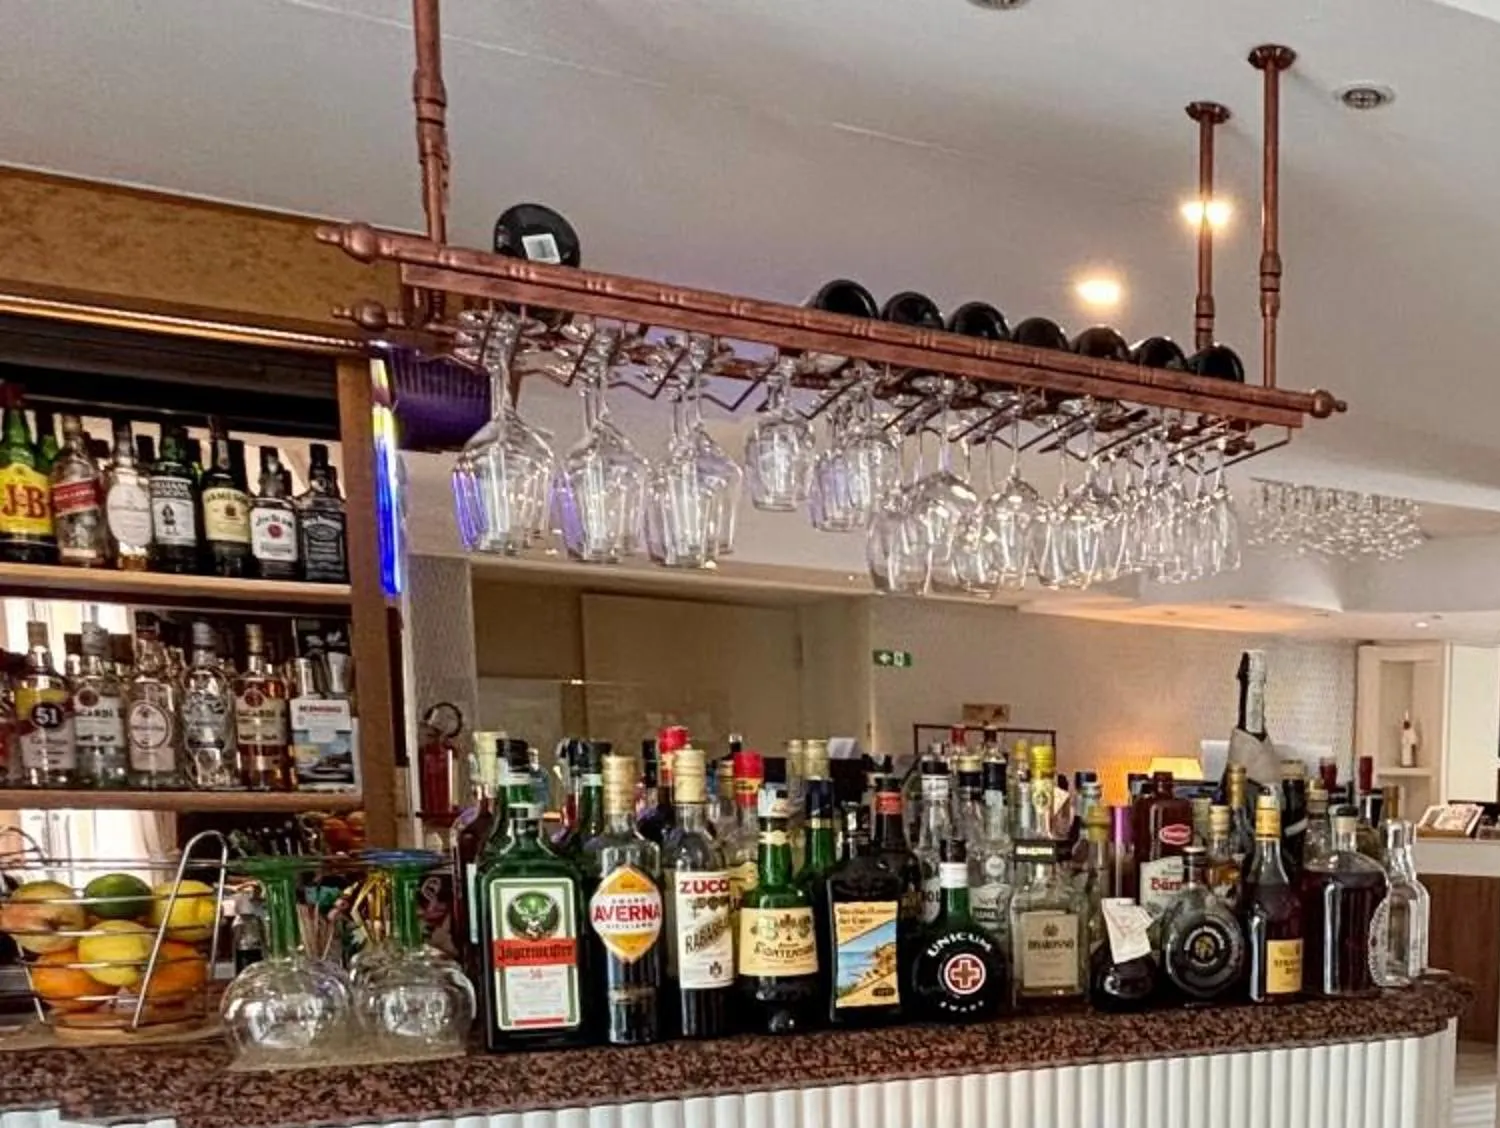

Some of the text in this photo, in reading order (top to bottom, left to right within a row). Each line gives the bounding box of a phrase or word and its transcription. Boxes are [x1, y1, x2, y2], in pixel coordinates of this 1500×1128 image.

[35, 707, 58, 725] 51
[593, 903, 661, 923] AVERNA
[926, 932, 992, 957] UNICUM
